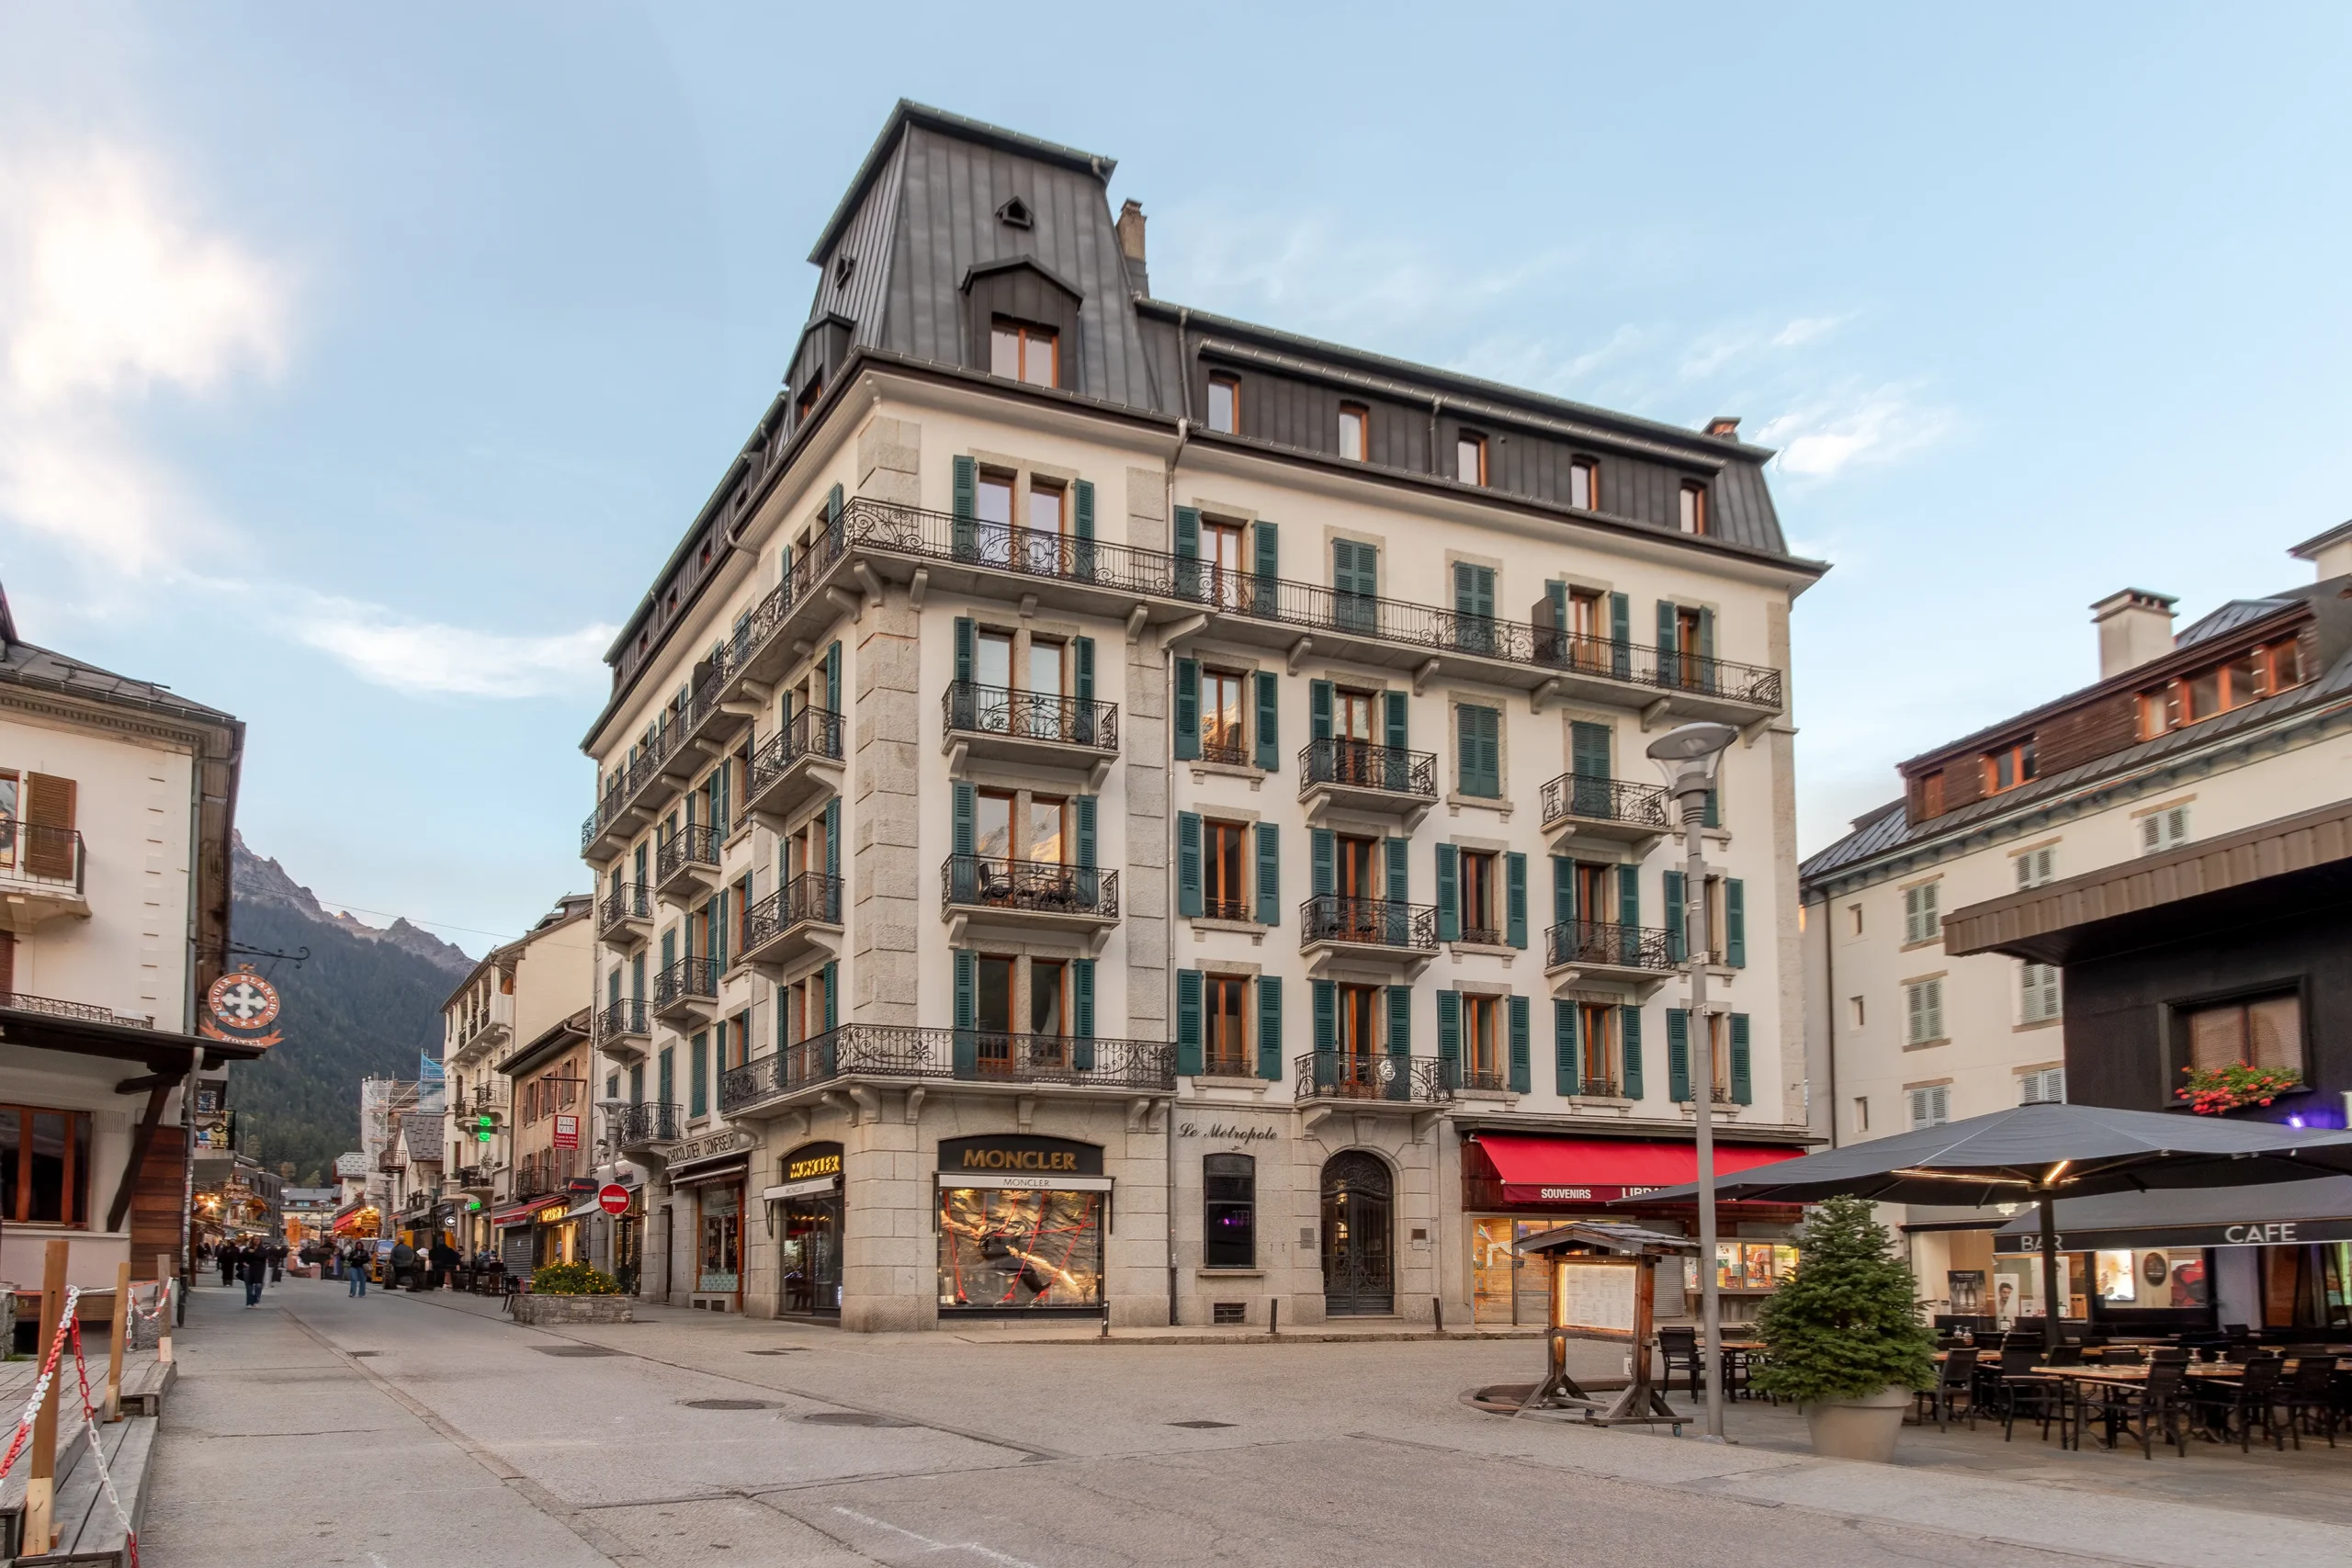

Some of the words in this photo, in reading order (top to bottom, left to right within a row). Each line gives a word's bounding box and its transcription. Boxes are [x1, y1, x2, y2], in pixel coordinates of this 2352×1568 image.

[212, 977, 232, 1012] CROIX
[240, 975, 277, 1019] BLANCHE
[221, 1034, 265, 1047] HOTEL
[559, 1117, 575, 1125] VIN
[559, 1125, 575, 1134] VIN
[1177, 1122, 1200, 1138] Le
[667, 1142, 702, 1164] CHOCOLATIER
[963, 1148, 1079, 1171] MONCLER
[1002, 1178, 1050, 1188] MONCLER
[1541, 1188, 1591, 1200] SOUVENIRS
[1622, 1187, 1665, 1199] LIB
[2224, 1223, 2298, 1244] CAFE
